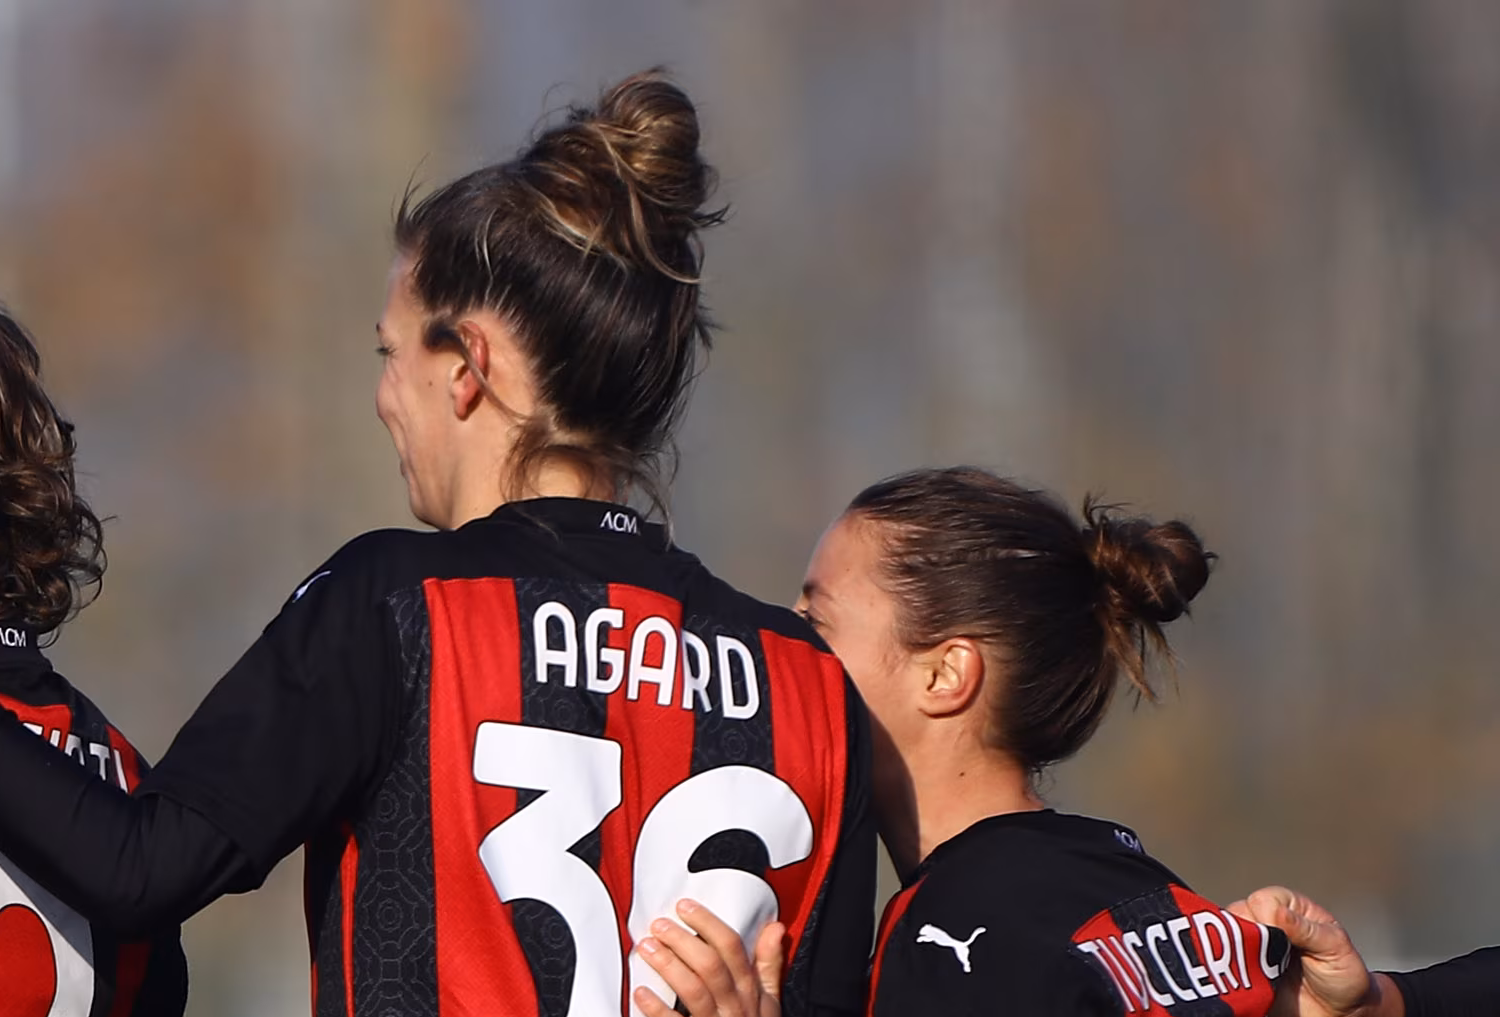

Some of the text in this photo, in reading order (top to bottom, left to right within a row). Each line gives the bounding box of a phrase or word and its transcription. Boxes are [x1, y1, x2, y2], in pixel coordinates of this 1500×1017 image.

[600, 510, 638, 534] ACM
[533, 600, 760, 721] AGARD
[1076, 909, 1252, 1013] TUCCERI
